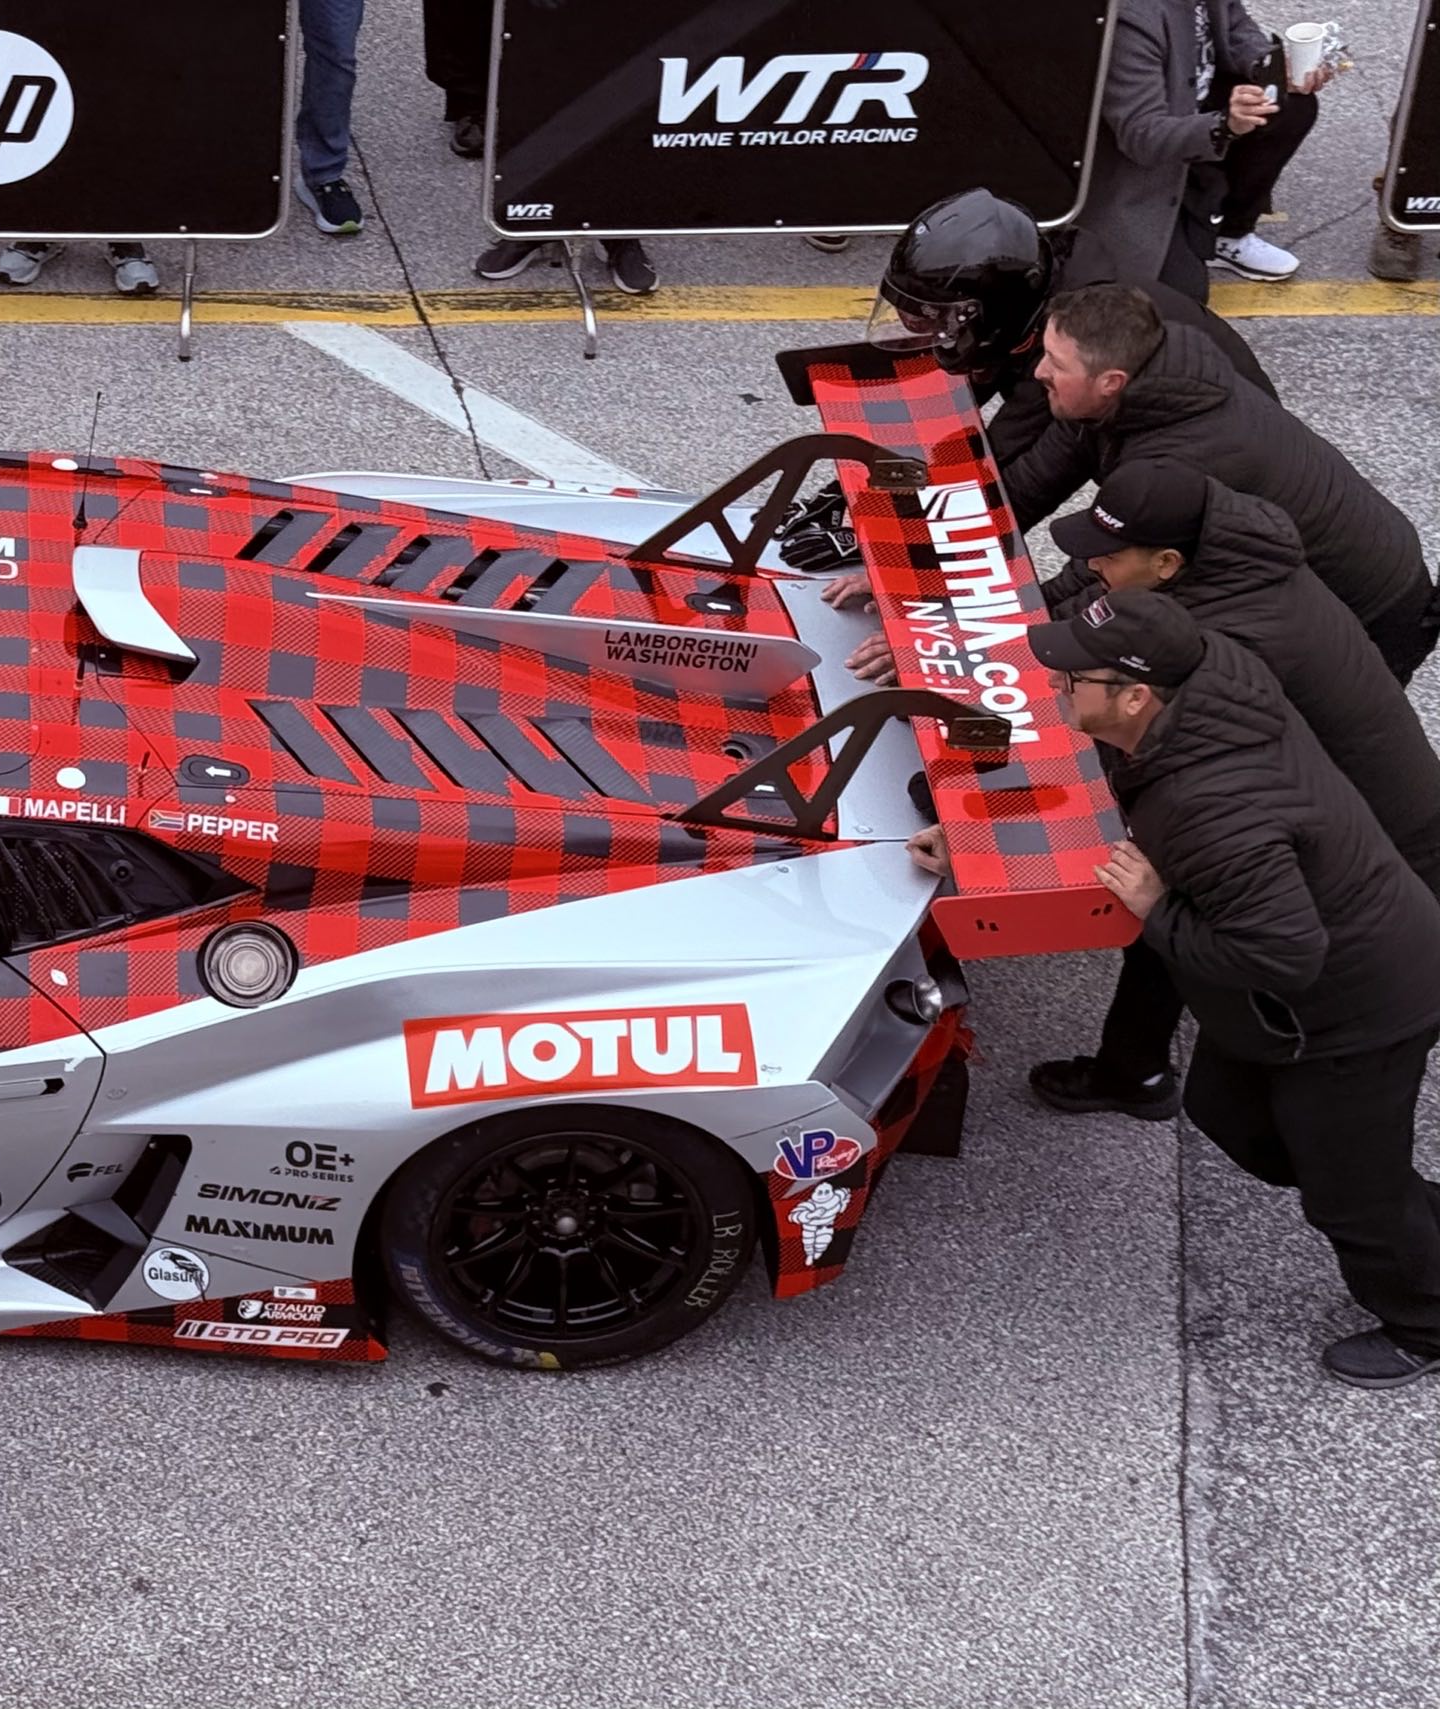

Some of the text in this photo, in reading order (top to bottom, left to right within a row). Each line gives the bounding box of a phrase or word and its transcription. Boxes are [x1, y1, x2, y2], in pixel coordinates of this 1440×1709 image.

[658, 52, 929, 124] WTR
[652, 127, 919, 147] WAYNE TAYLOR RACING
[506, 203, 554, 217] WTR
[1406, 197, 1440, 209] WT
[604, 630, 758, 658] LAMBORGHINI
[927, 514, 1041, 743] LITHIA.COM
[607, 645, 750, 672] WASHINGTON
[24, 798, 126, 825] MAPELLI
[187, 814, 279, 842] PEPPER
[424, 1014, 742, 1094] MOTUL
[92, 1163, 124, 1176] FEL
[285, 1140, 355, 1171] OE+
[777, 1129, 837, 1180] VP
[185, 1214, 335, 1245] MAXIMUM
[684, 1248, 740, 1307] ROLLER
[209, 1326, 341, 1344] GTD PRO
